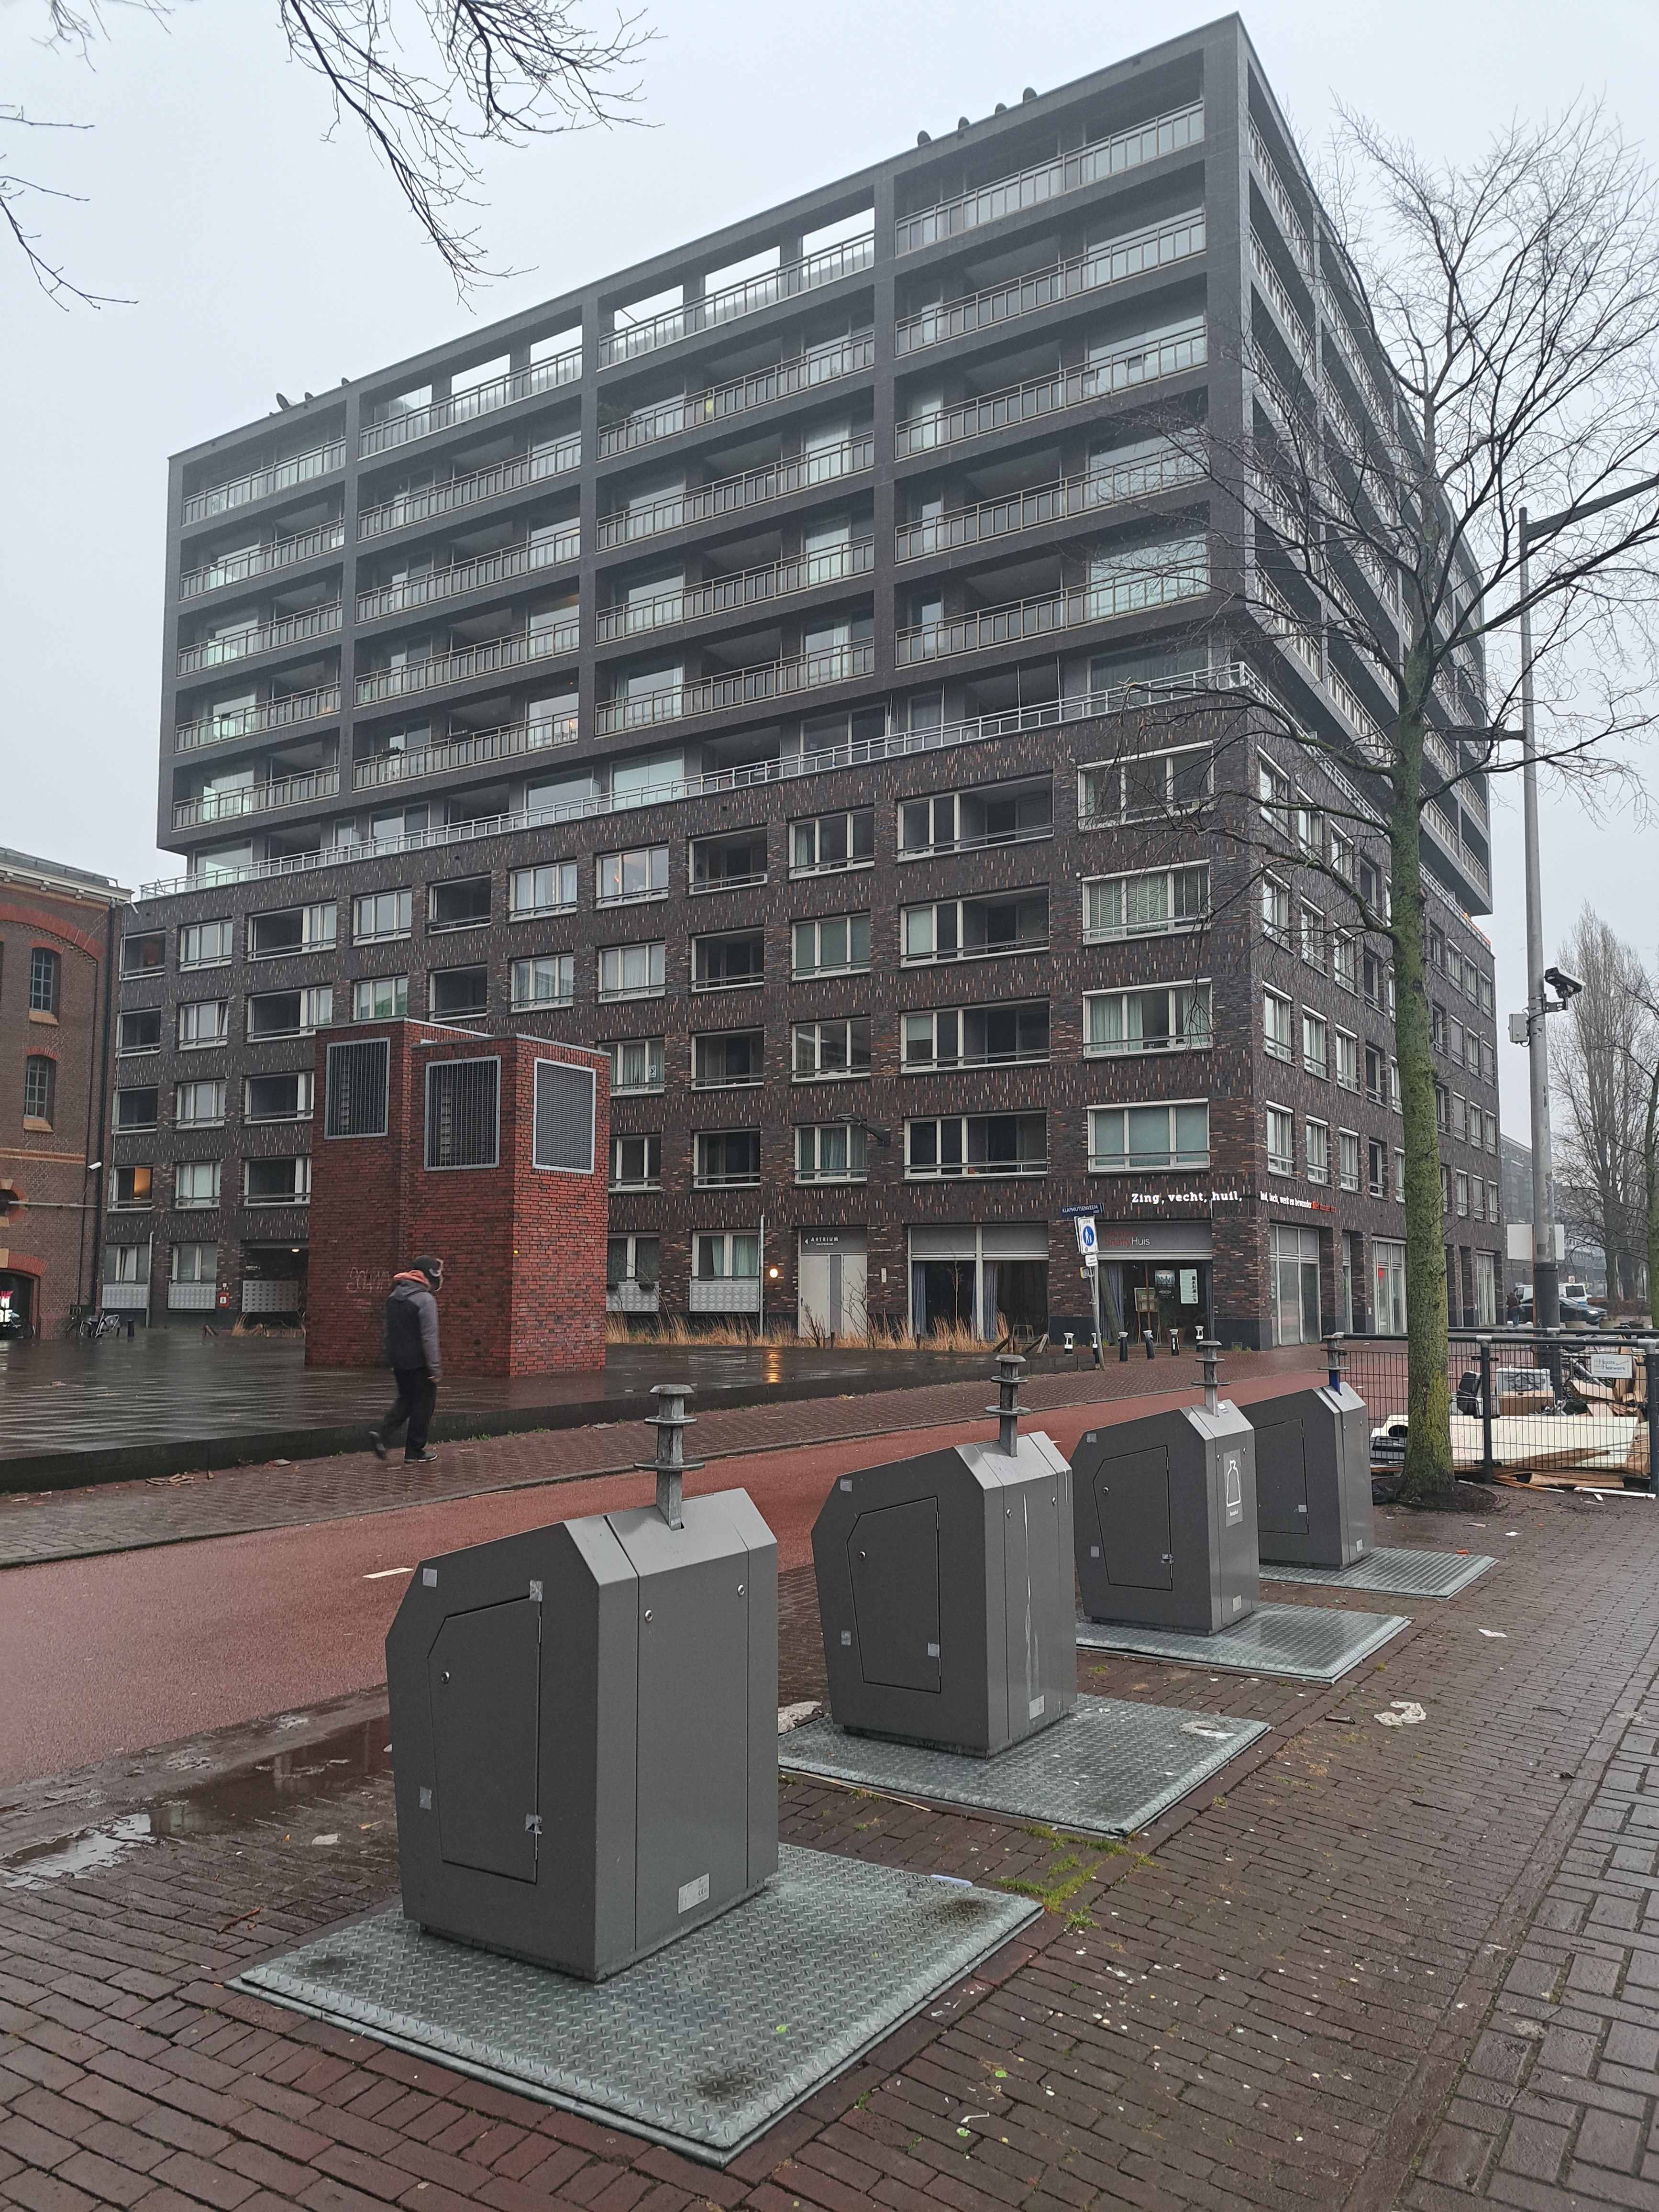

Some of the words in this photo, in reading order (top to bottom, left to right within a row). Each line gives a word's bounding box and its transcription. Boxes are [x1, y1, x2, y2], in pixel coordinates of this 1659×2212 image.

[1131, 1193, 1164, 1205] Zing,
[1168, 1191, 1207, 1203] vecht,
[1212, 1190, 1242, 1202] huil,
